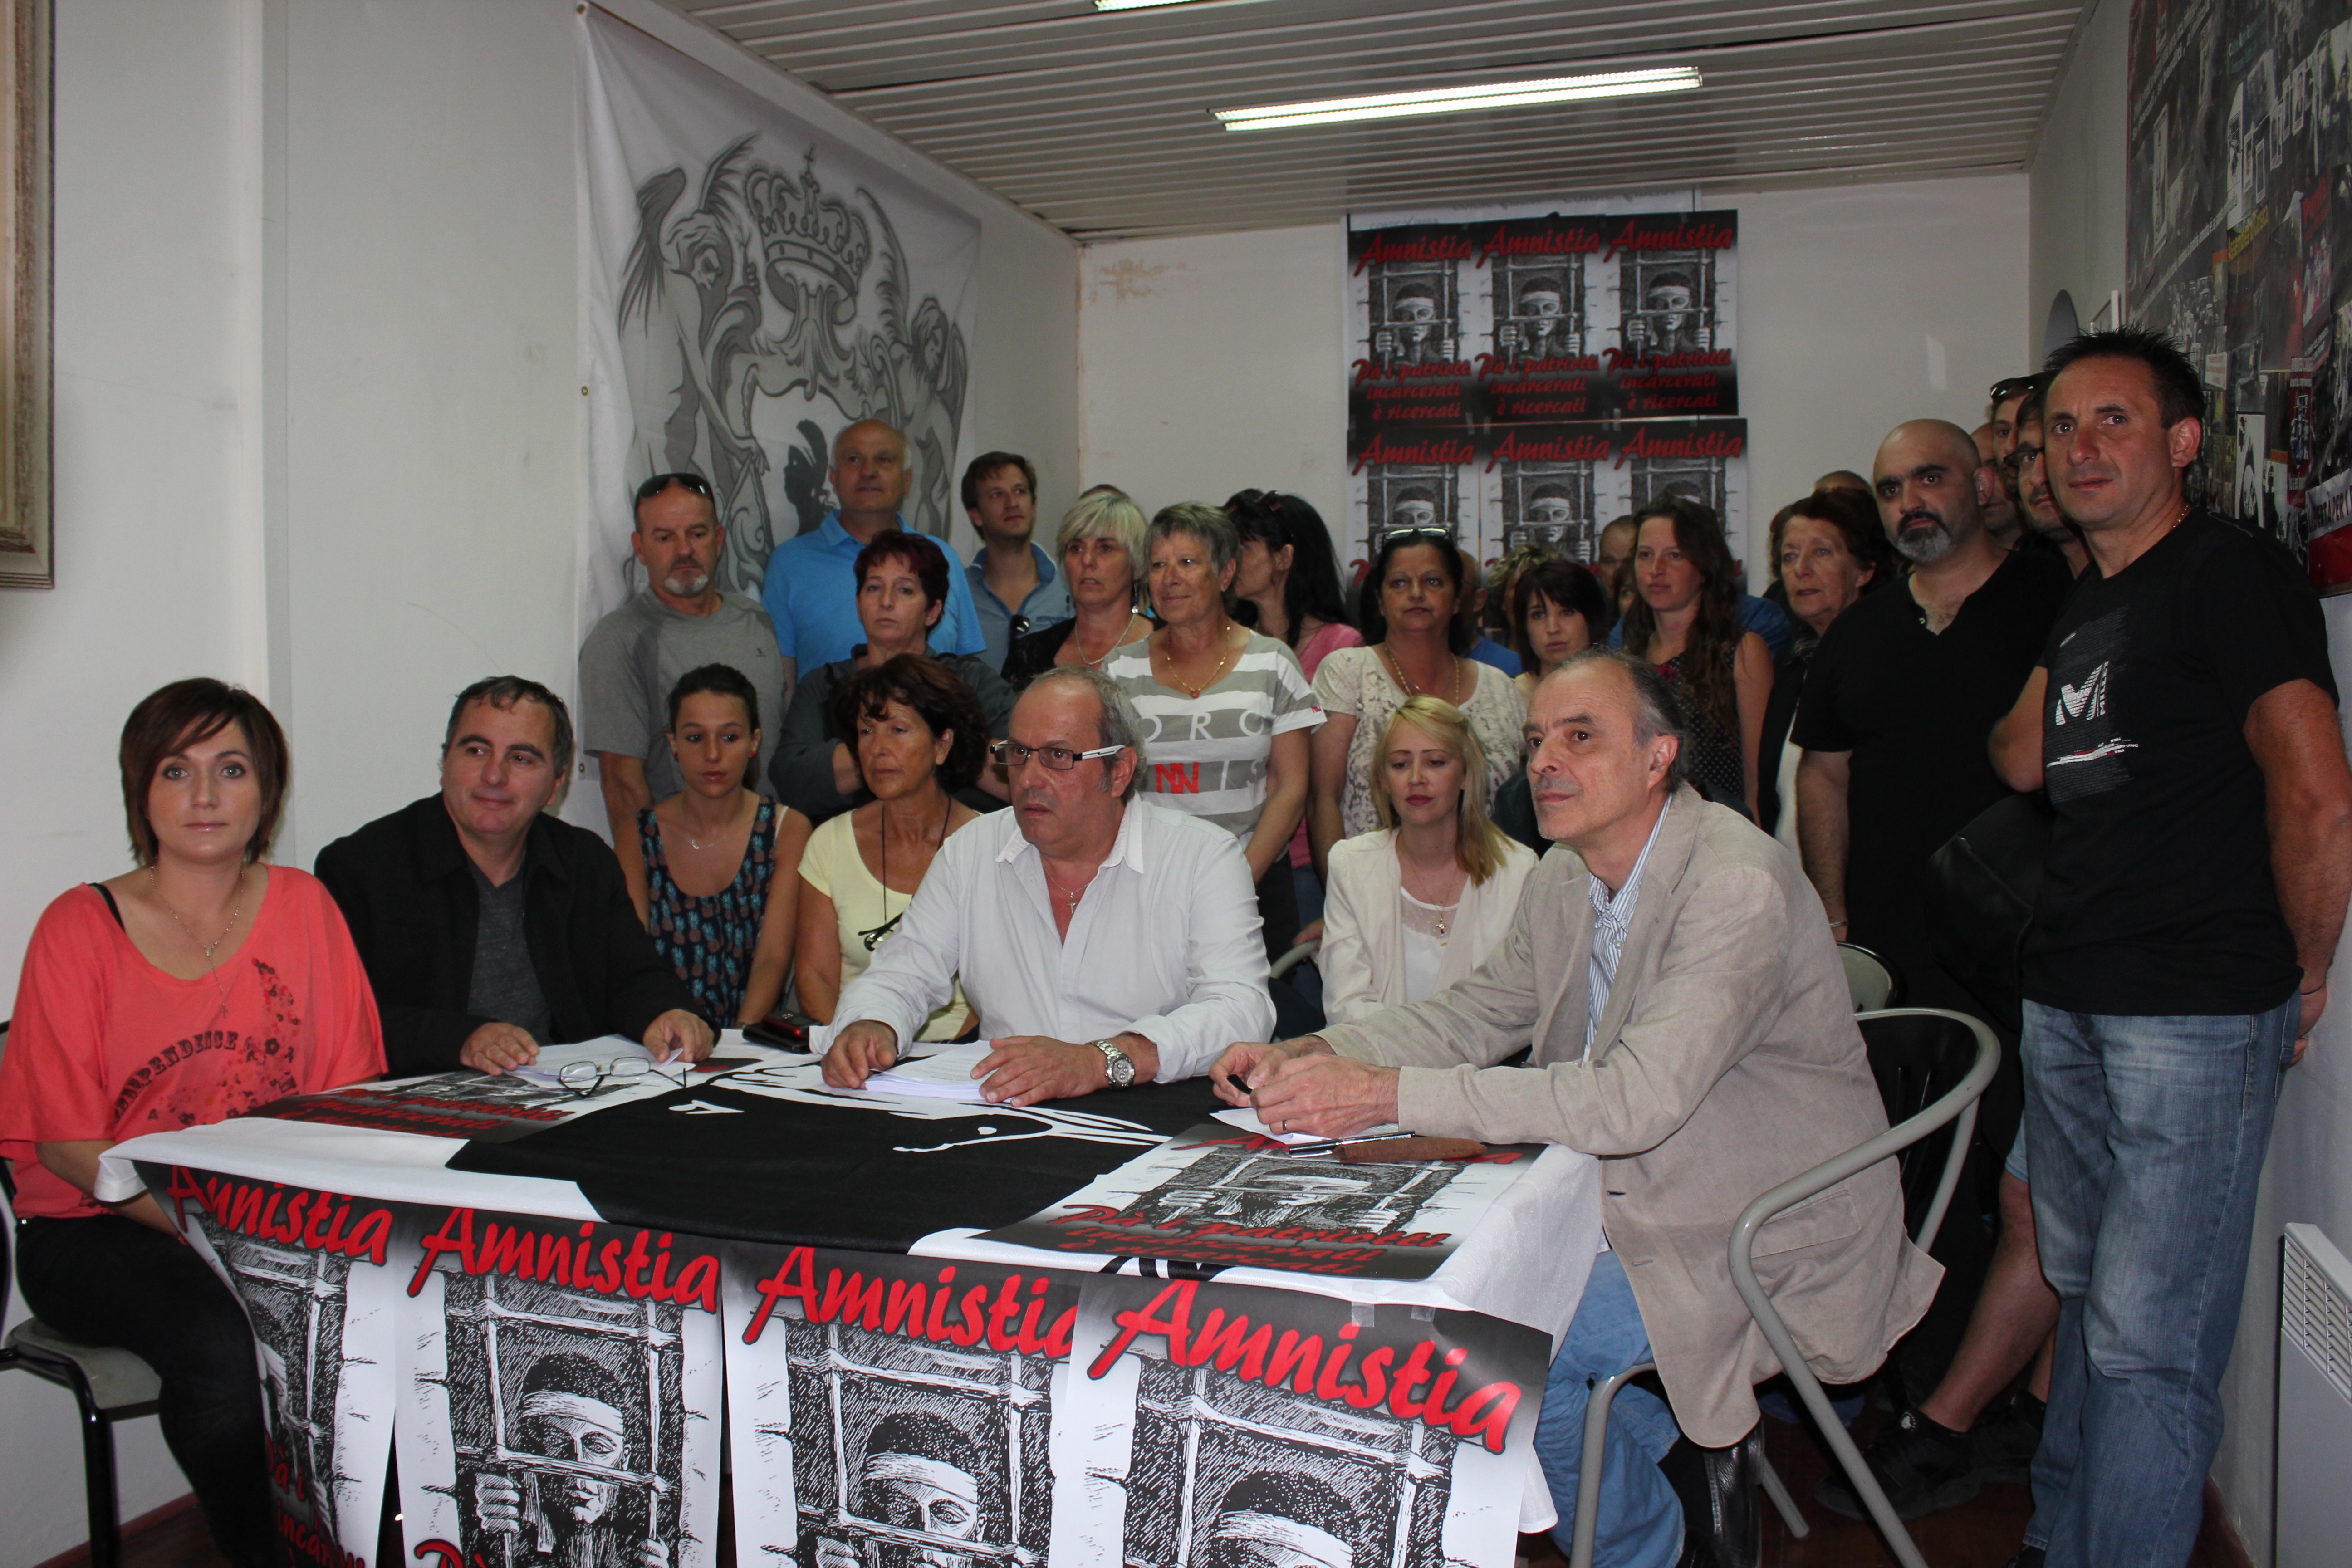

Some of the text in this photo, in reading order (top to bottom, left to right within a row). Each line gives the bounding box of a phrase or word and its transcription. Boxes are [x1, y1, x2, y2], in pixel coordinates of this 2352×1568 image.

[1355, 234, 1471, 276] Amnistia
[1477, 225, 1599, 269] Amnistia
[1604, 220, 1733, 262] Amnistia
[1353, 359, 1472, 385] Pà i patriotti
[1476, 354, 1599, 380] Pà i patriotti
[1602, 348, 1730, 375] Pà i patriotti
[1366, 382, 1460, 399] incarcerati
[1491, 377, 1586, 394] incarcerati
[1620, 372, 1716, 389] incarcerati
[1387, 403, 1460, 419] ricercati
[1512, 397, 1587, 414] ricercati
[1643, 393, 1717, 409] ricercati
[1353, 433, 1475, 475] Amnistia
[1485, 431, 1610, 473] Amnistia
[1615, 426, 1742, 469] Amnistia
[1051, 1205, 1145, 1226] Pà
[1184, 1223, 1451, 1246] patriotti
[409, 1207, 719, 1311] Amnistia
[1090, 1279, 1521, 1452] Amnistia
